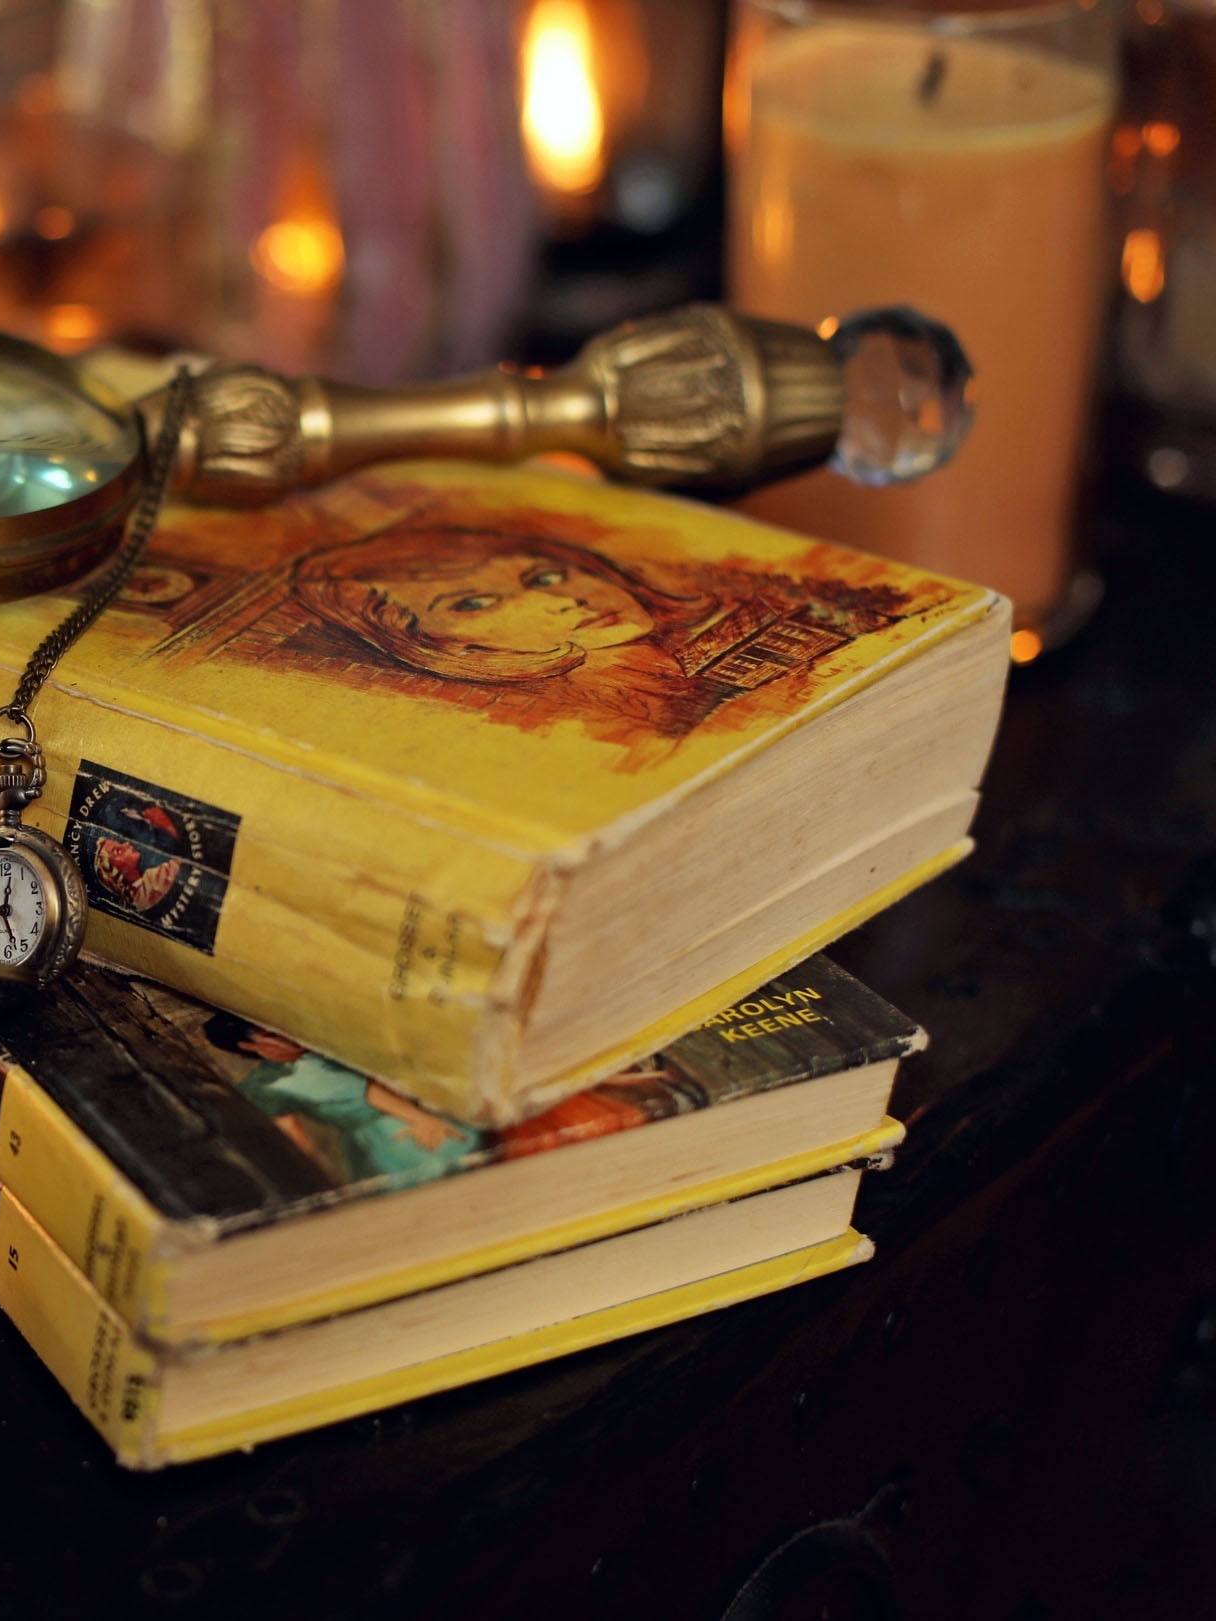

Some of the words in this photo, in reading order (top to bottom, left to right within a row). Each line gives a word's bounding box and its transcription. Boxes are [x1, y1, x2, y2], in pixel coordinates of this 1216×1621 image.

[80, 780, 110, 817] DREW
[0, 863, 12, 876] 12
[31, 881, 38, 894] 2
[161, 867, 202, 929] MYSTERY
[36, 902, 43, 915] 3
[30, 922, 38, 936] 4
[4, 945, 12, 959] 6
[20, 939, 28, 952] 5
[696, 987, 822, 1031] AROLYN
[720, 1009, 819, 1043] KEENE
[9, 1130, 22, 1156] 43
[8, 1245, 19, 1271] 15
